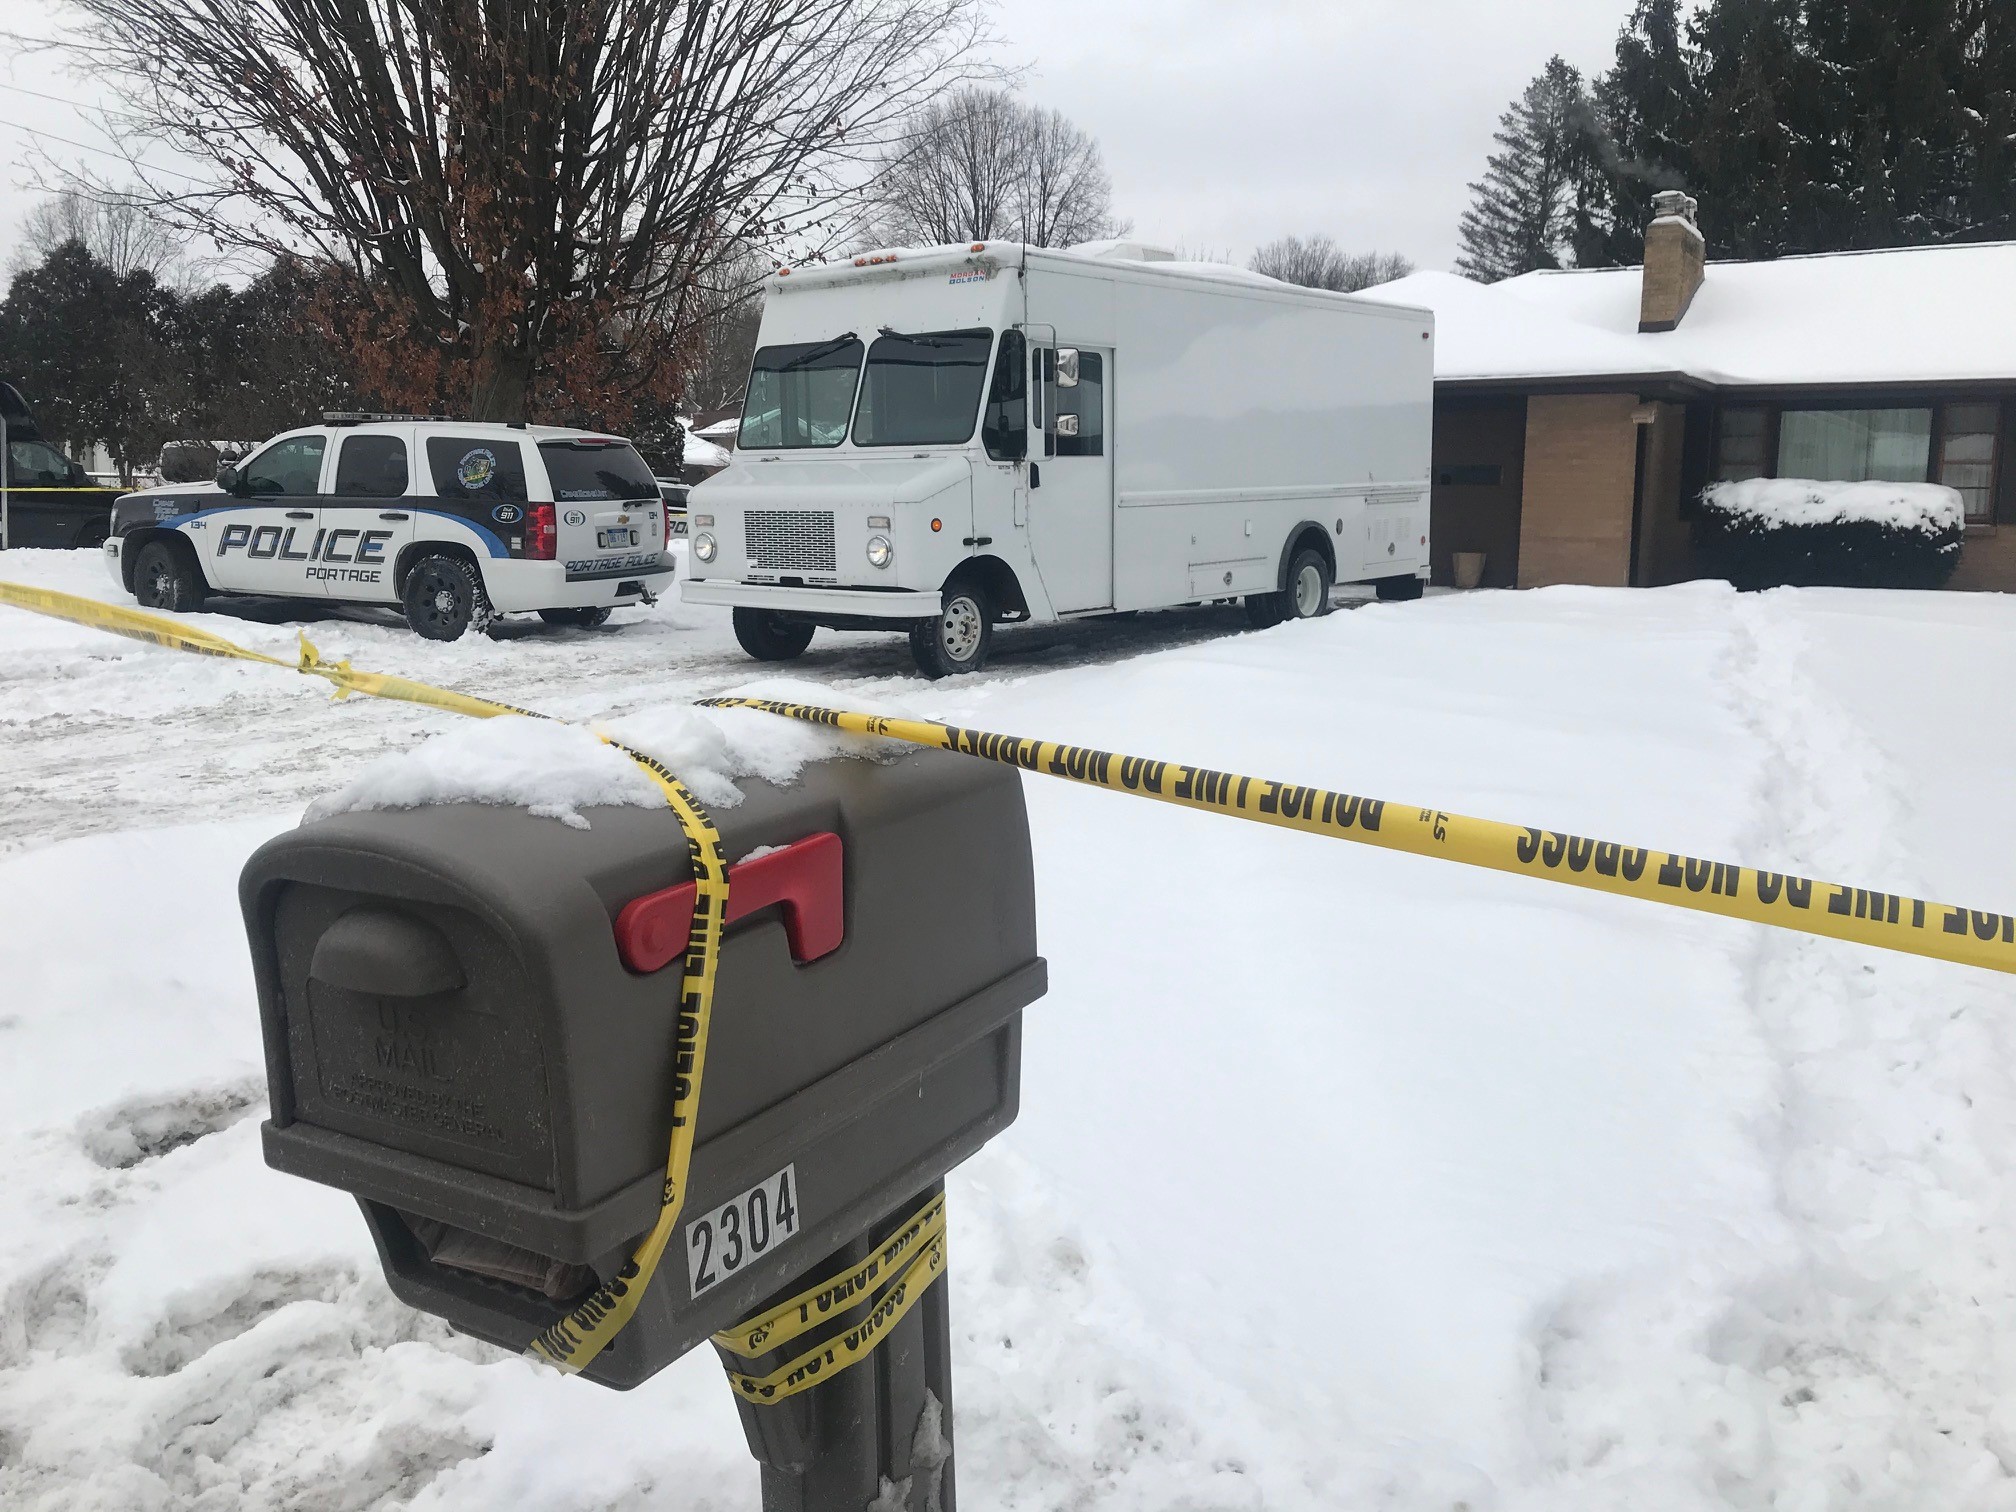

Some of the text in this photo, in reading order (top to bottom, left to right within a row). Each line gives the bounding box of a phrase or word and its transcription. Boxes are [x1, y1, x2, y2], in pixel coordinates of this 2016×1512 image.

[501, 511, 514, 520] 911
[570, 516, 581, 524] 911
[191, 521, 207, 529] 134
[216, 524, 394, 565] POLICE
[565, 553, 659, 572] PORTAGE POLICE
[305, 567, 382, 583] PORTAGE
[691, 1170, 796, 1291] 2304
